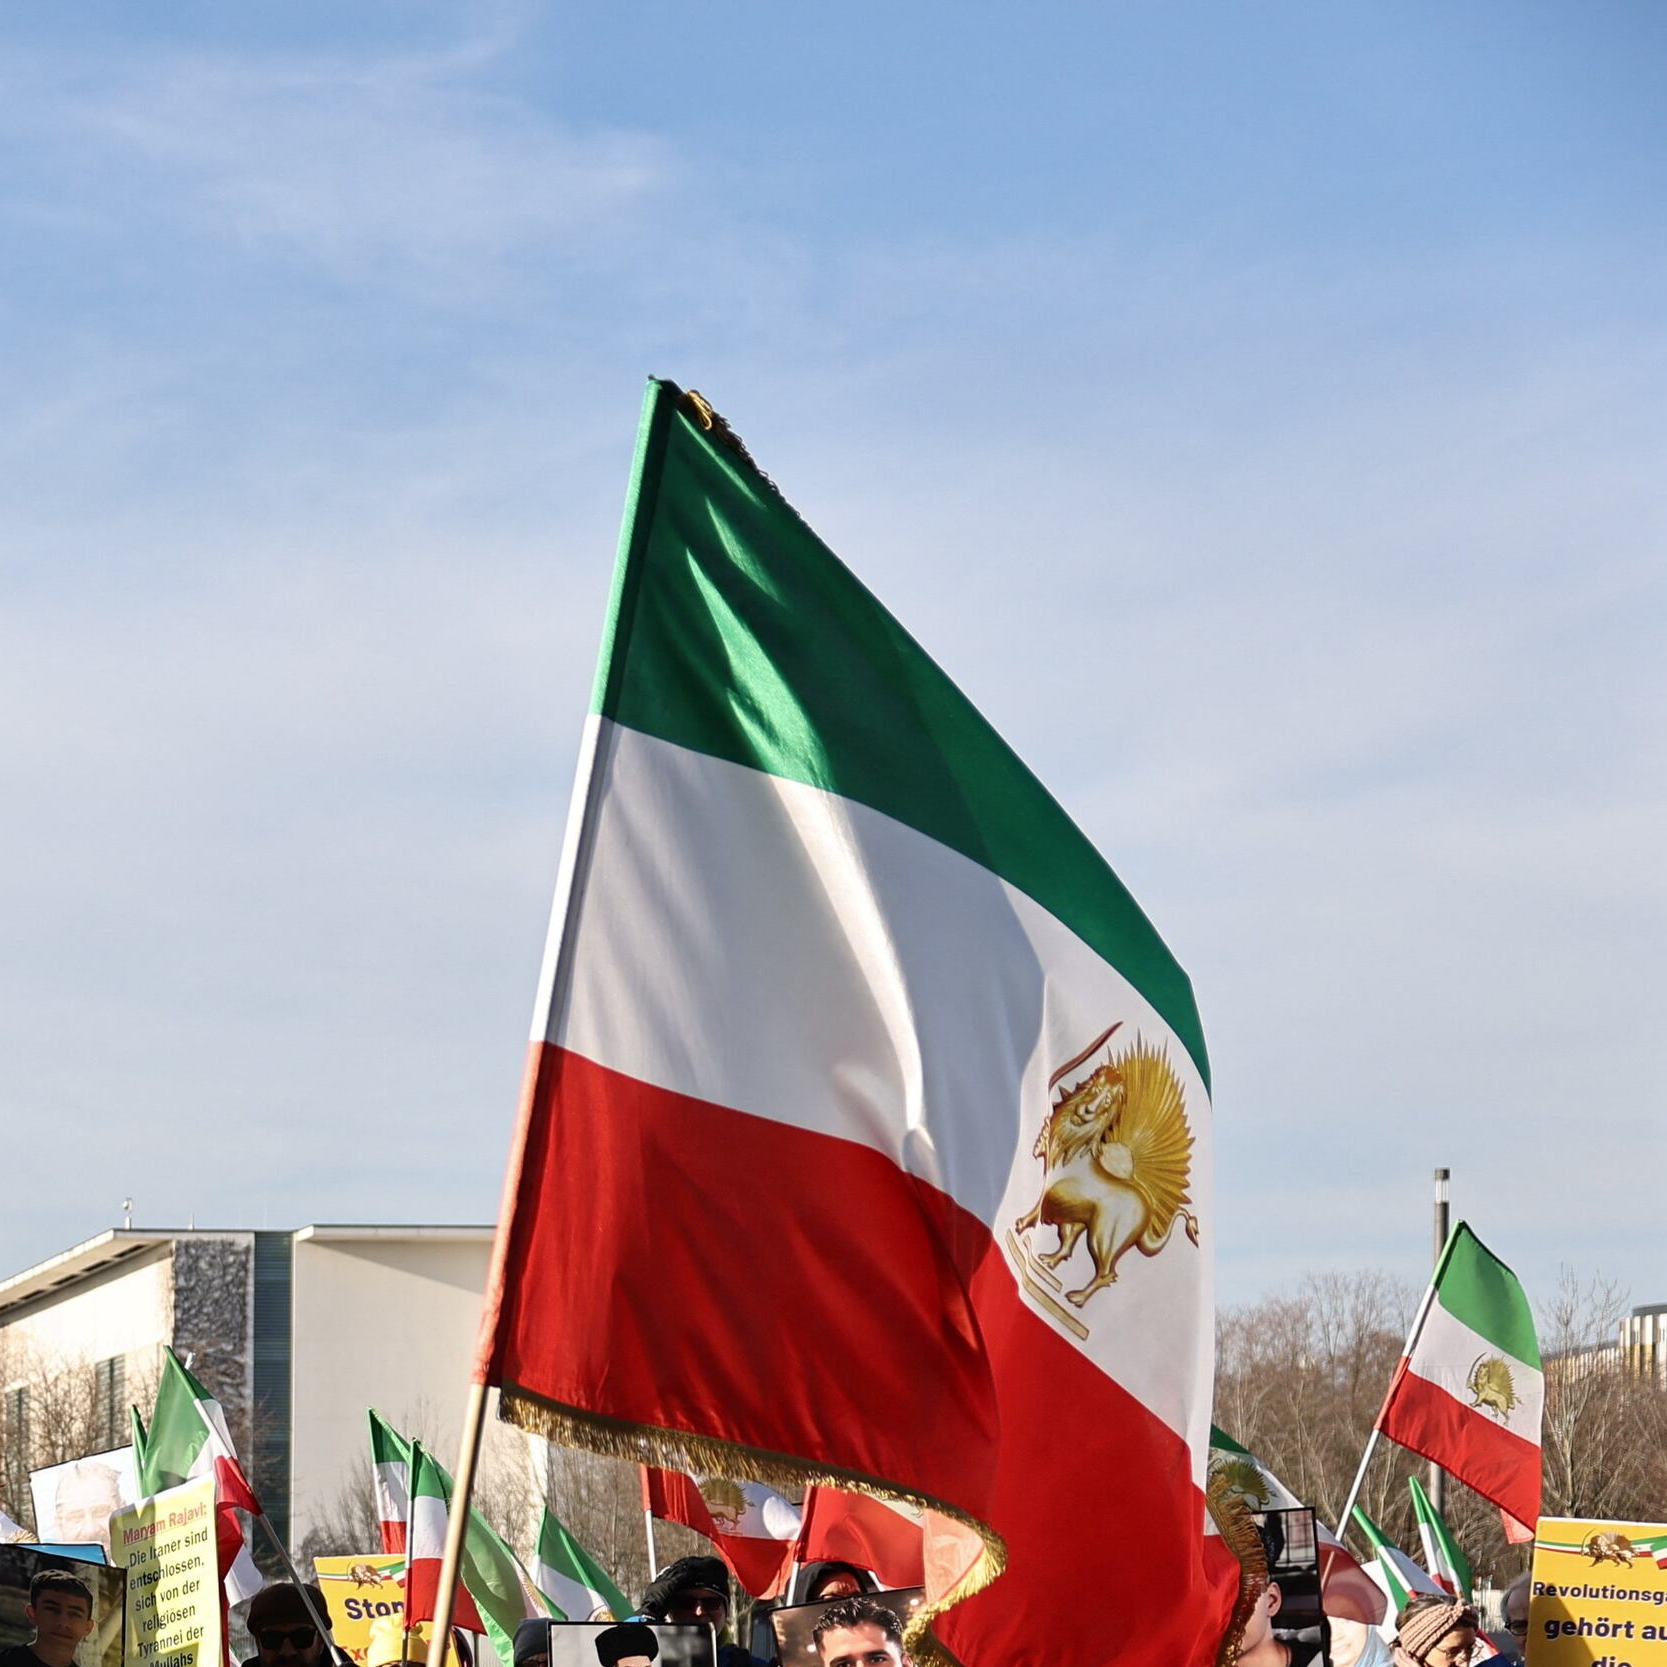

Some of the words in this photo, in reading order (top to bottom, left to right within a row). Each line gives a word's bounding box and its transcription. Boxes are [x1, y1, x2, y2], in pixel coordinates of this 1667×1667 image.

[123, 1518, 166, 1545] Maryam
[169, 1502, 207, 1529] Rajavi:
[150, 1539, 181, 1560] Iraner
[185, 1527, 208, 1547] sind
[135, 1589, 156, 1611] sich
[160, 1585, 179, 1601] von
[182, 1579, 200, 1596] der
[142, 1605, 196, 1632] religiösen
[1544, 1617, 1634, 1639] gehört
[137, 1629, 183, 1659] Tyrannei
[187, 1625, 204, 1643] der
